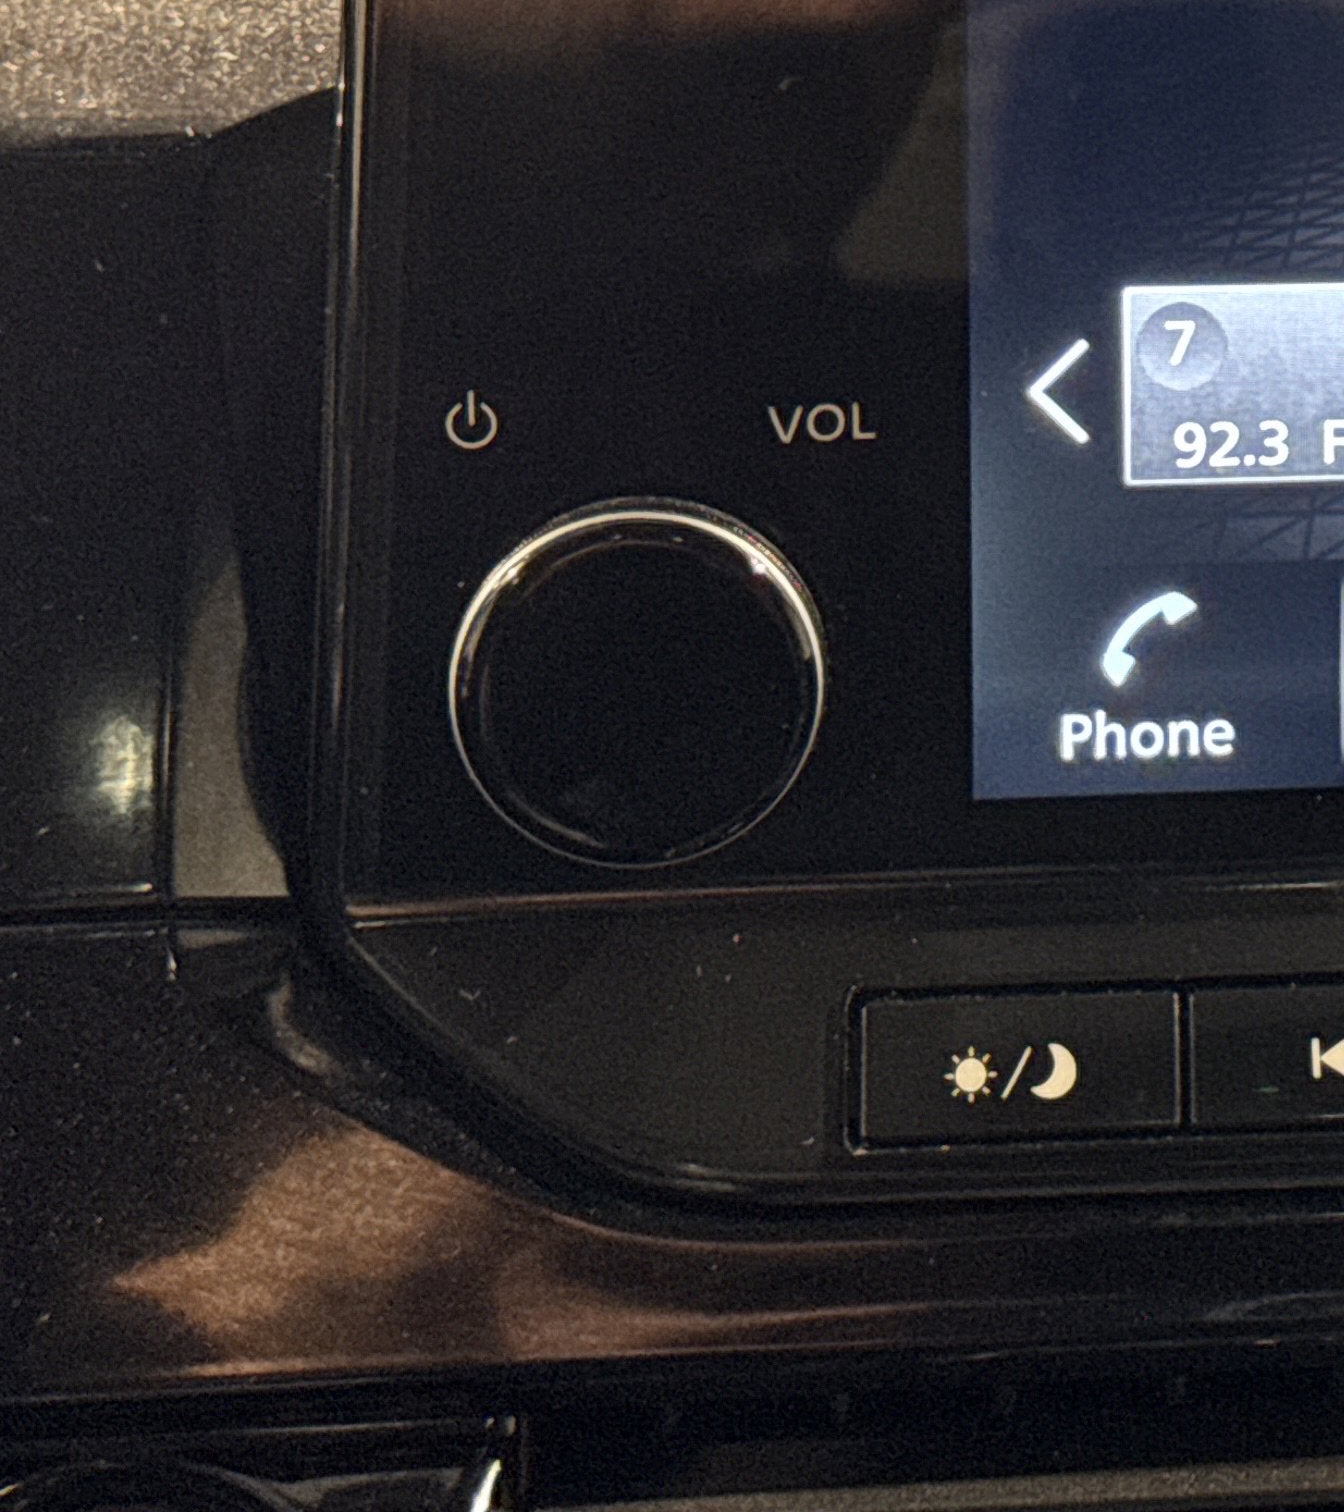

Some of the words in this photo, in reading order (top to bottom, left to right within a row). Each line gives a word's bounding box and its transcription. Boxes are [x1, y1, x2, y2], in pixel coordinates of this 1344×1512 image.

[1163, 320, 1196, 365] 7
[768, 402, 876, 444] VOL
[1172, 420, 1289, 467] 92.3
[1060, 711, 1234, 762] Phone
